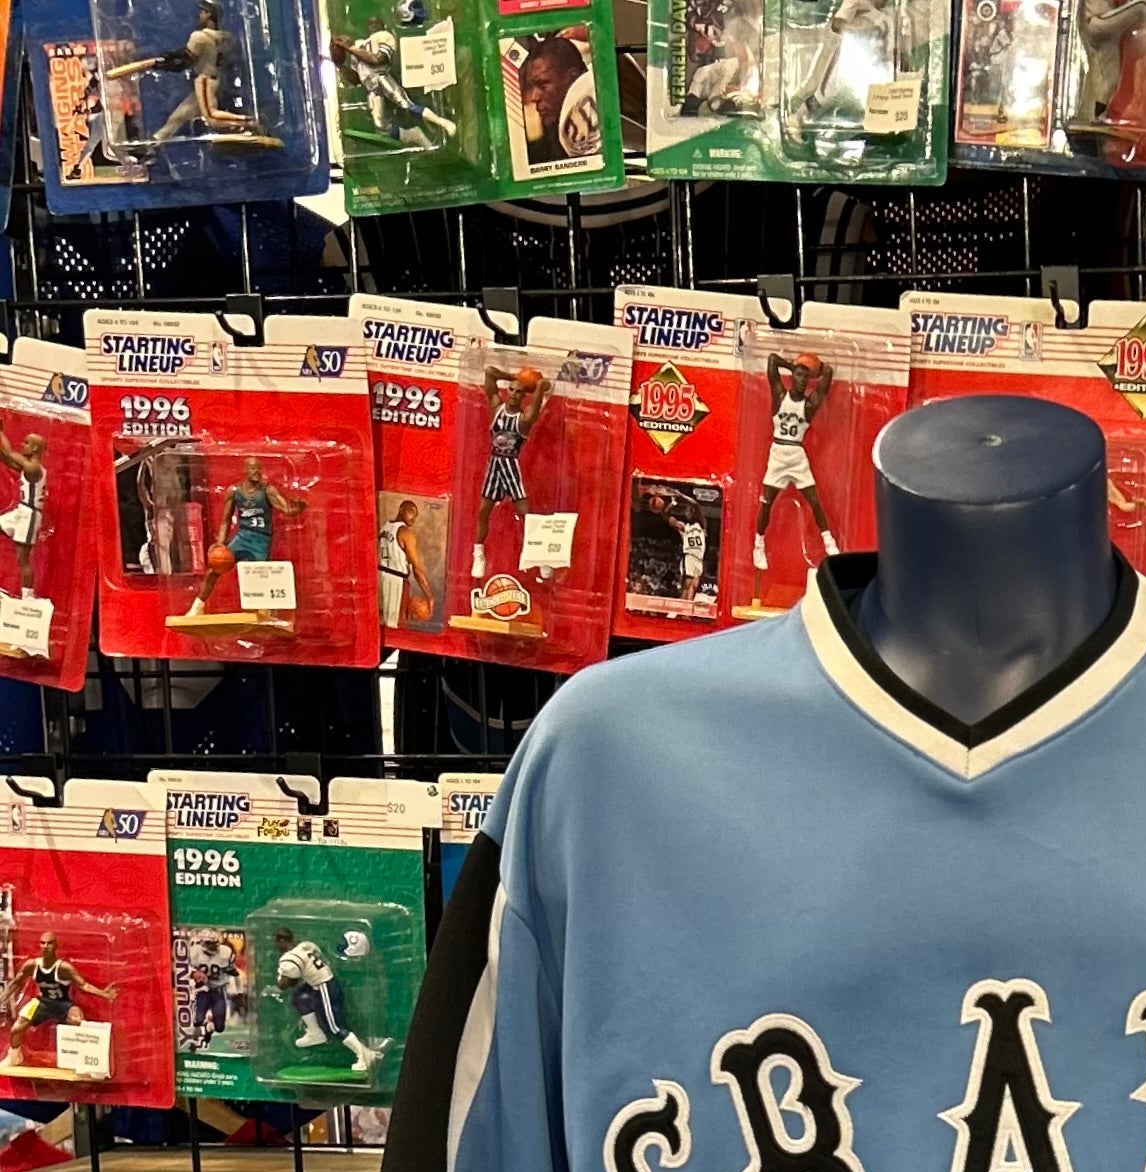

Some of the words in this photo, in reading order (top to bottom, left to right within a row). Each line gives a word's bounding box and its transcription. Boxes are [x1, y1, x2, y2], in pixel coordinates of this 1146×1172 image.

[430, 64, 445, 76] $30
[671, 38, 686, 106] TERRELL
[625, 304, 724, 333] STARTING
[911, 313, 1008, 337] STARTING
[363, 320, 454, 348] STARTING
[639, 326, 710, 350] LINEUP
[923, 333, 995, 355] LINEUP
[102, 335, 196, 357] STARTING
[376, 340, 441, 365] LINEUP
[118, 353, 184, 374] LINEUP
[321, 350, 342, 373] 50
[64, 380, 87, 404] 50
[373, 381, 441, 412] 1996
[640, 381, 696, 420] 1995
[121, 396, 190, 421] 1996
[372, 408, 441, 428] EDITION
[122, 422, 191, 437] EDITION
[643, 421, 690, 432] EDITION
[780, 424, 798, 438] 50
[250, 516, 265, 528] 33
[687, 536, 703, 548] 50
[270, 589, 287, 599] $25
[167, 792, 250, 813] STARTING
[387, 802, 406, 815] $20
[116, 813, 139, 835] 50
[177, 809, 240, 829] LINEUP
[173, 848, 240, 873] 1996
[175, 872, 241, 888] EDITION
